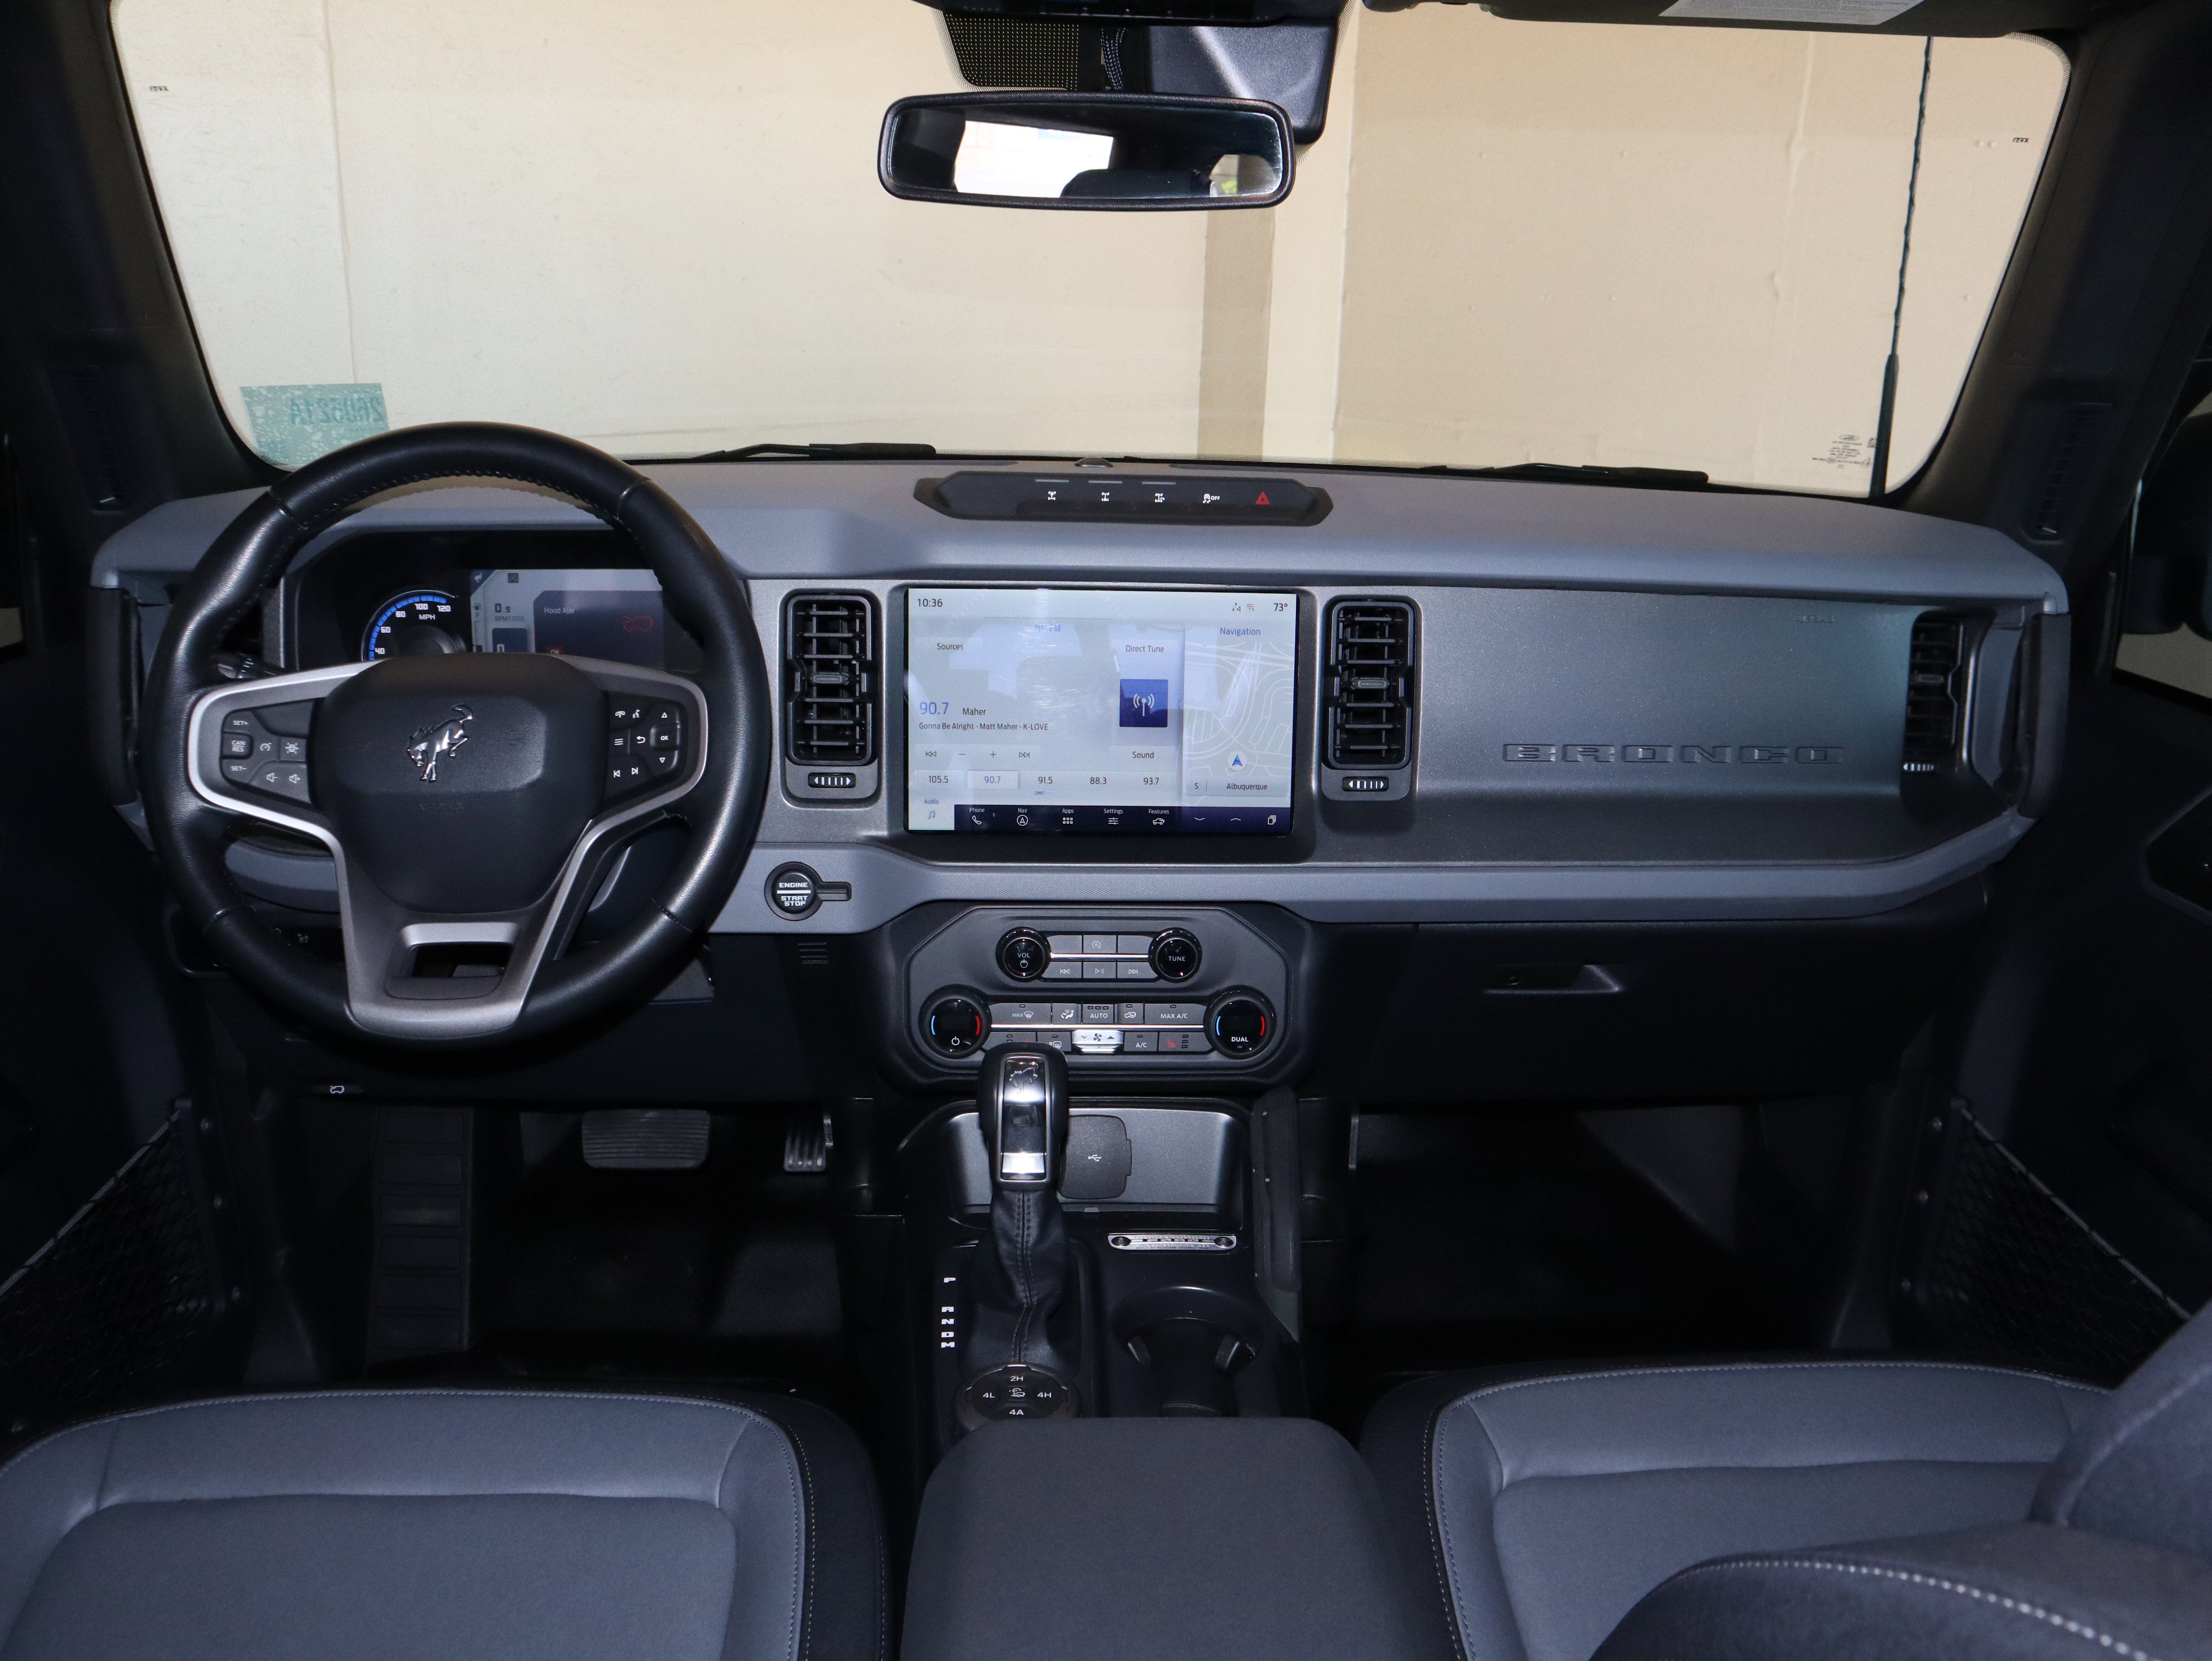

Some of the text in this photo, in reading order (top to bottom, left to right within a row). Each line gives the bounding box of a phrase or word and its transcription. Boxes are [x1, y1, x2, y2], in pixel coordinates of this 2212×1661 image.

[918, 599, 942, 607] 10:36
[1273, 603, 1288, 611] 73°
[1220, 627, 1260, 636] Navigation
[919, 702, 949, 715] 90.7
[1502, 744, 1843, 763] BRONCO
[1226, 783, 1267, 791] Albuquerque
